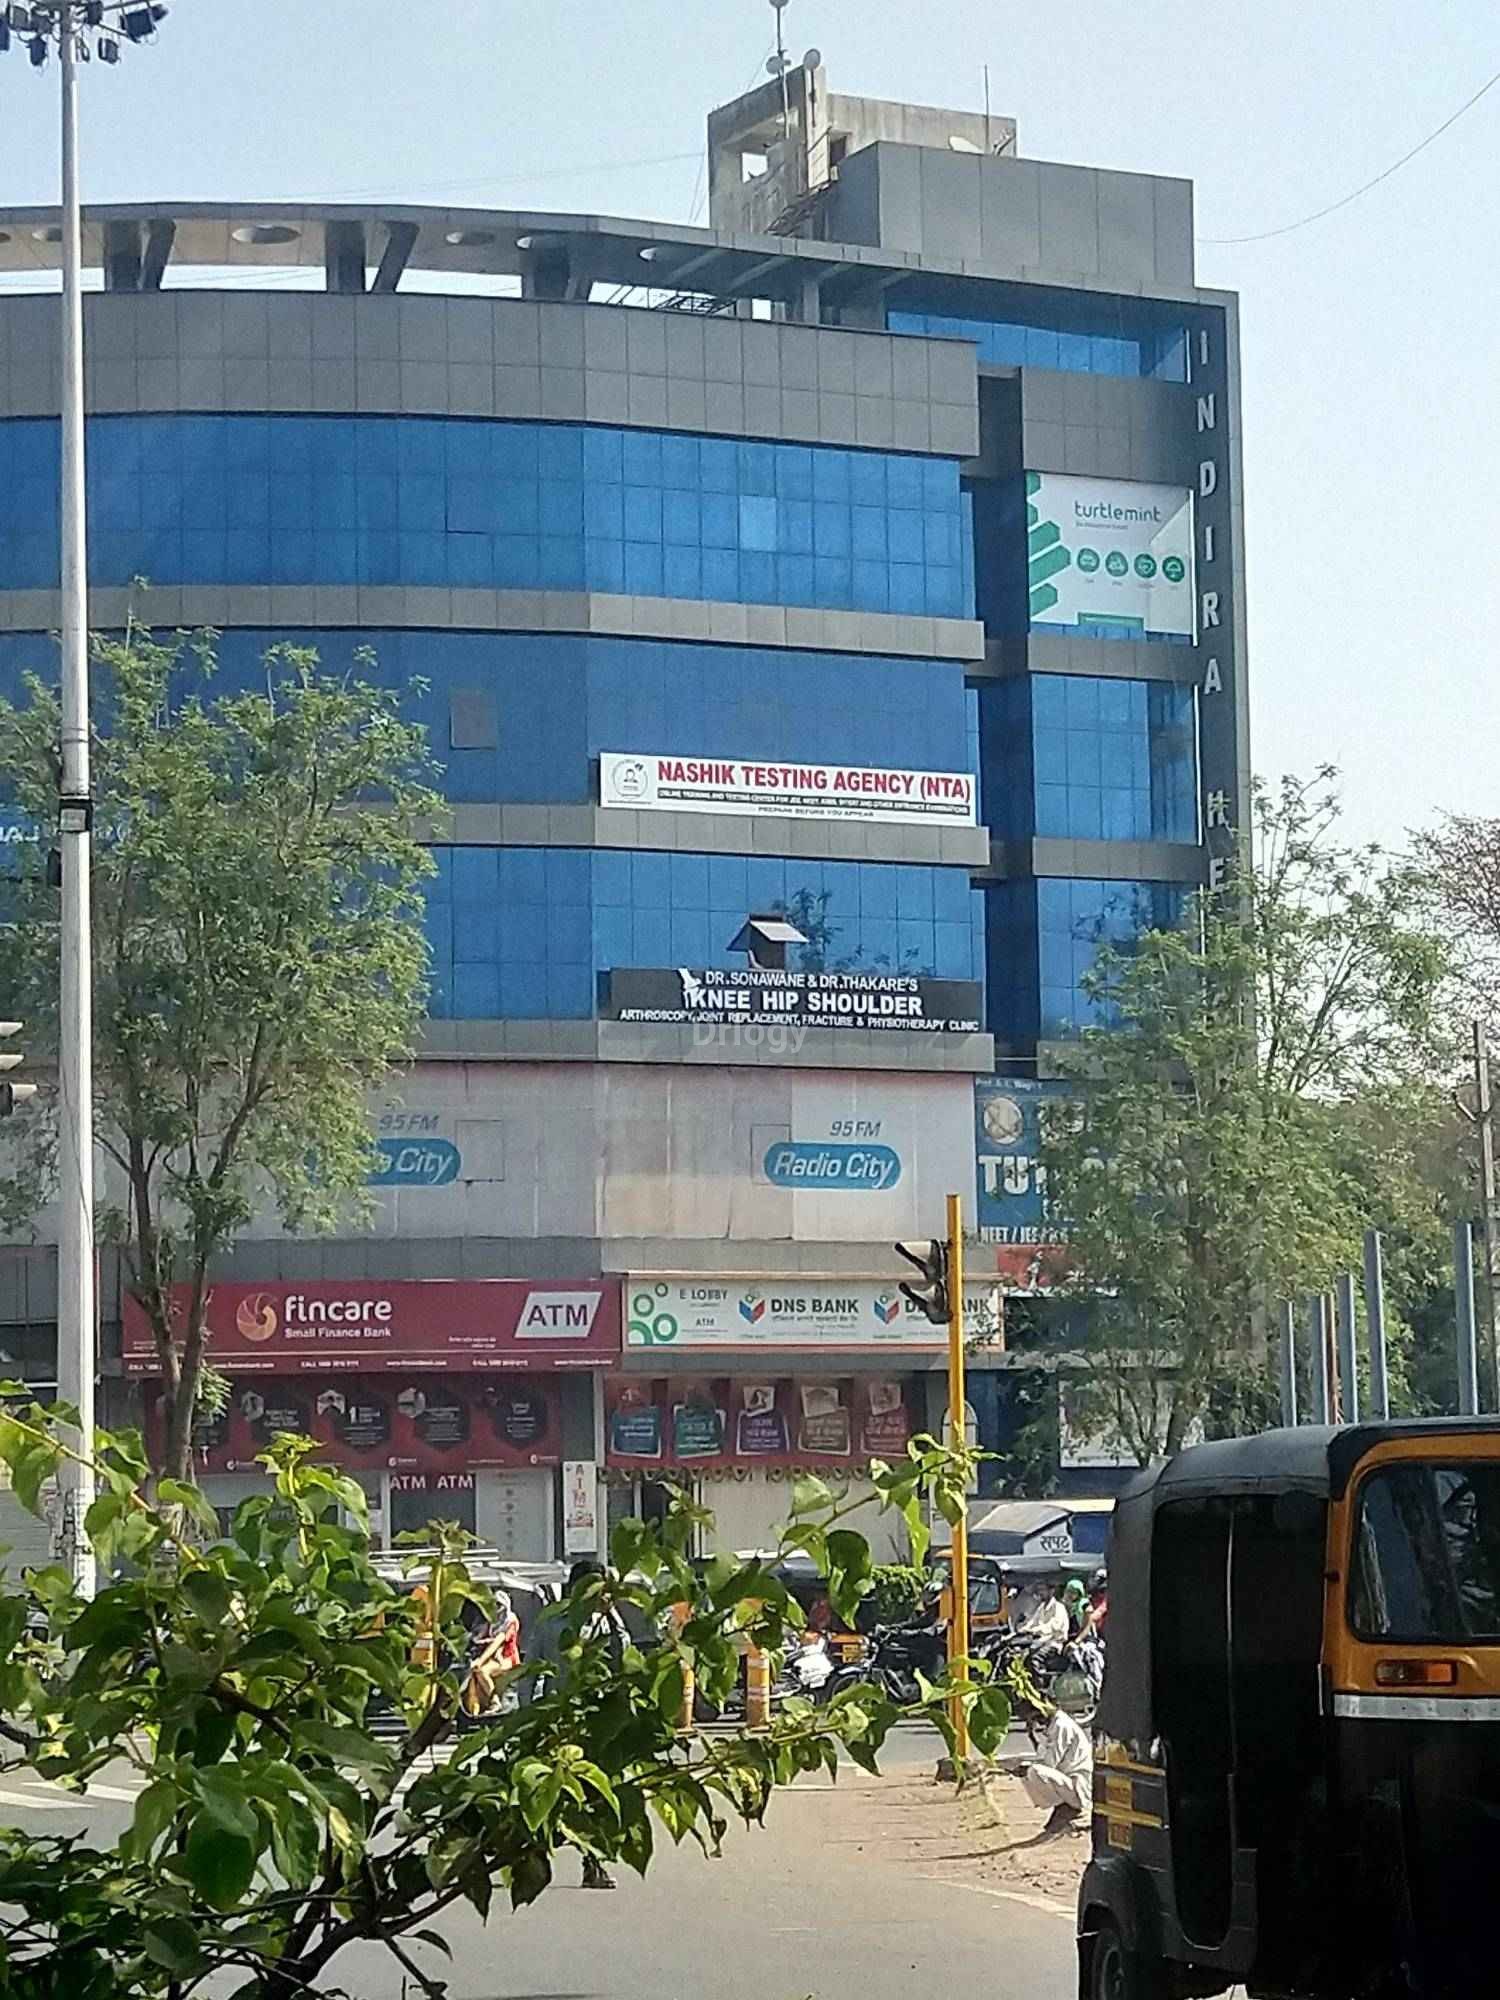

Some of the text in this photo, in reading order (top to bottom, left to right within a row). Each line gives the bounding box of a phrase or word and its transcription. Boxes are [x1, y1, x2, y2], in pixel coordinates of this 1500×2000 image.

[1075, 500, 1162, 522] turtlemint
[1197, 329, 1224, 695] INDIRA
[658, 760, 971, 803] NASHIK TESTING AGENCY (NTA)
[705, 971, 805, 988] DR.SONAWANE
[807, 975, 819, 988] &
[689, 989, 923, 1016] KNEE HIP SHOULDER
[856, 1017, 864, 1027] &
[397, 1147, 454, 1184] City
[774, 1151, 895, 1188] Radio City
[285, 1295, 392, 1323] fincare
[526, 1304, 588, 1327] ATM
[771, 1299, 859, 1313] DNS BANK
[285, 1327, 391, 1338] Small Finance Bank
[390, 1474, 473, 1490] ATM ATM
